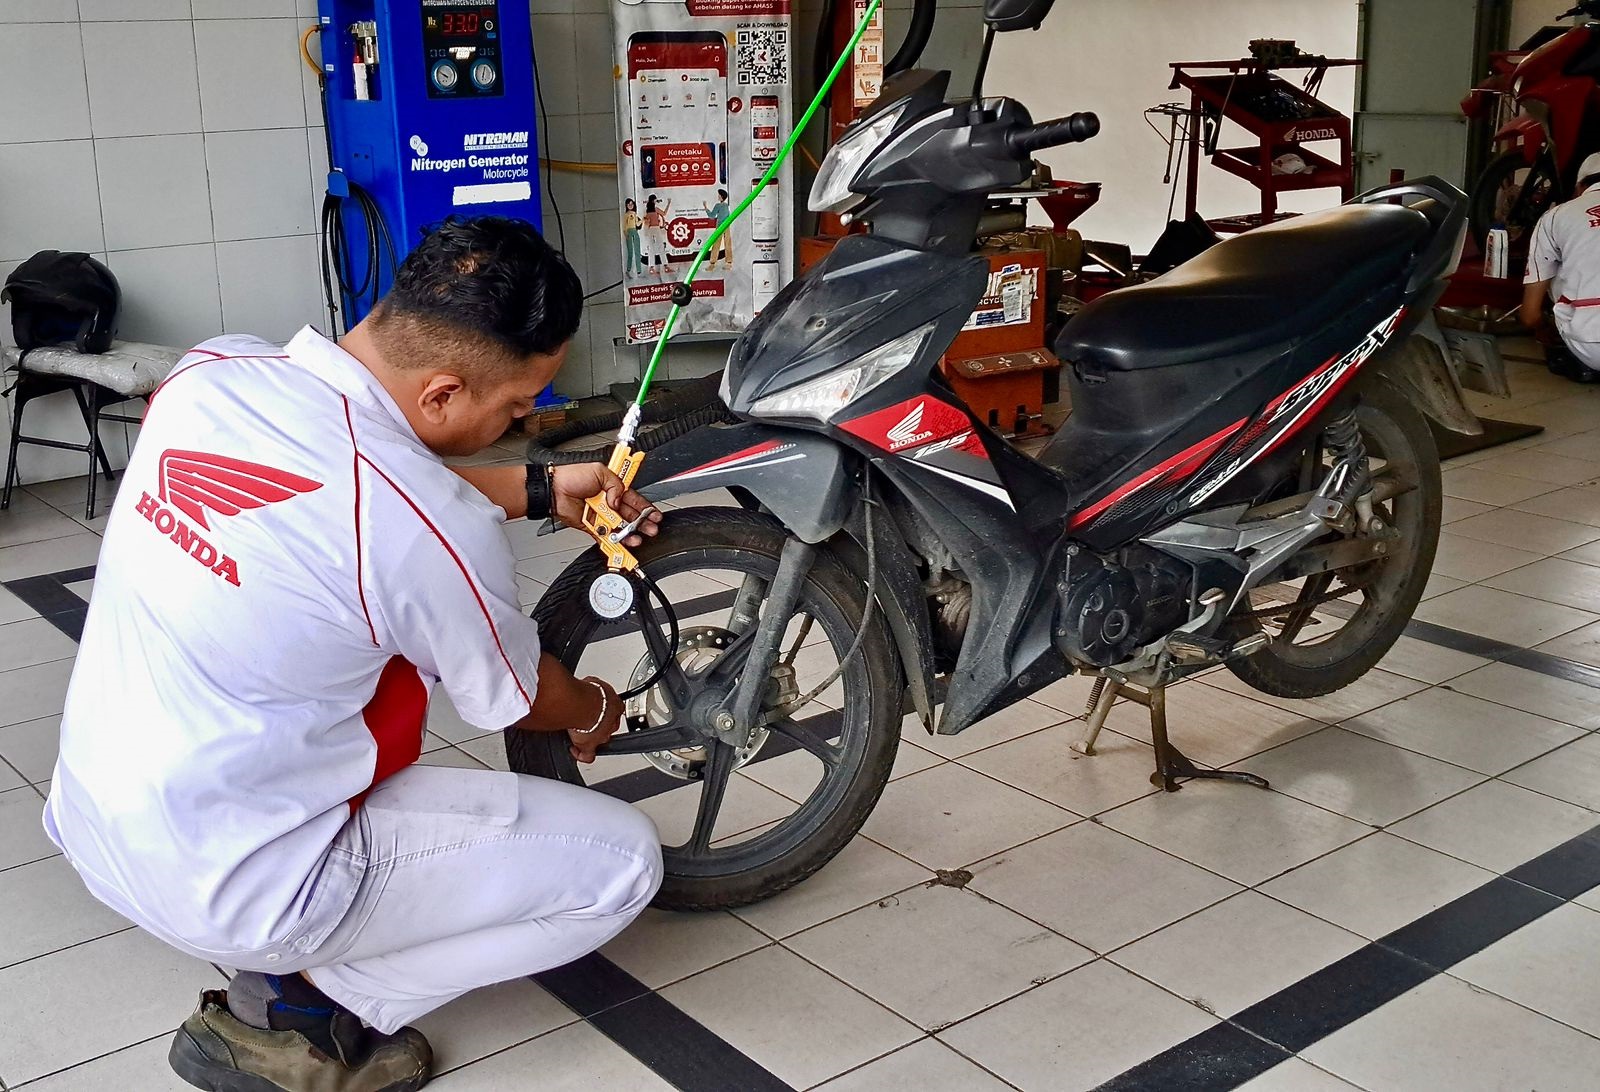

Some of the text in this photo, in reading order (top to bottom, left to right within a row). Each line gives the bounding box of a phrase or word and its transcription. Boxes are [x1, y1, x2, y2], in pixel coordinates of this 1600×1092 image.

[464, 131, 528, 145] NITROMAN
[1296, 128, 1337, 140] HONDA
[411, 153, 528, 172] Nitrogen Generator
[483, 166, 528, 180] Motorcycle
[632, 295, 649, 303] Motor
[889, 430, 933, 450] HONDA
[913, 430, 972, 460] 125
[135, 491, 241, 587] HONDA
